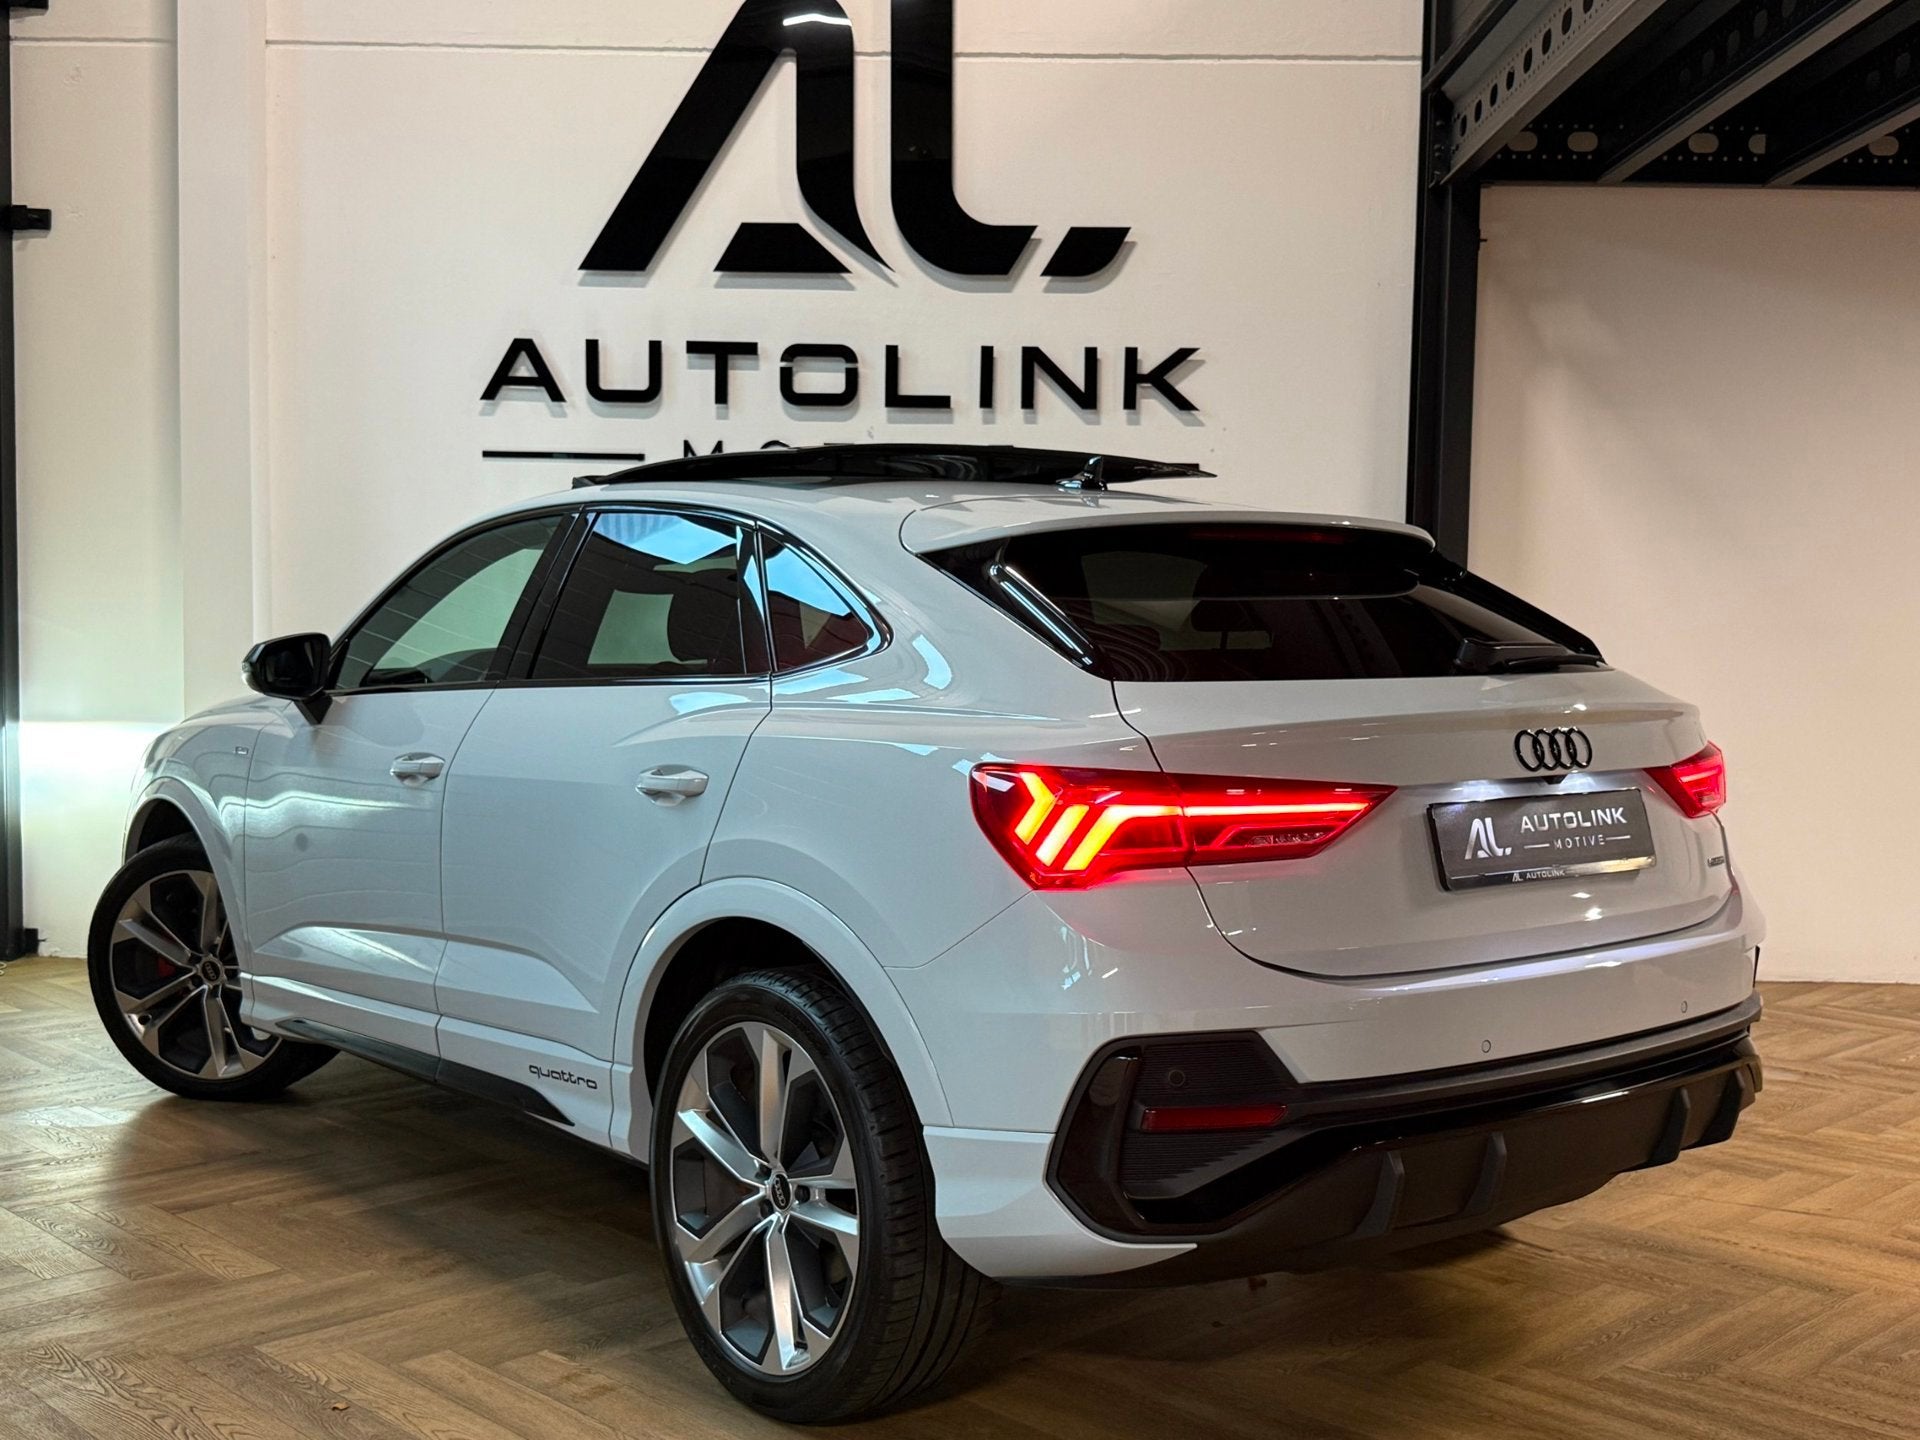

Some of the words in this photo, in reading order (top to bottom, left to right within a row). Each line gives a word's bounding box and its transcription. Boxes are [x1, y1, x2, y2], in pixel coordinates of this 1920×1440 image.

[480, 338, 1200, 411] AUTOLINK
[1520, 807, 1627, 833] AUTOLINK
[1554, 834, 1605, 850] MOTIVE
[1526, 870, 1566, 880] AUTOLINK
[528, 1064, 598, 1089] quattro
